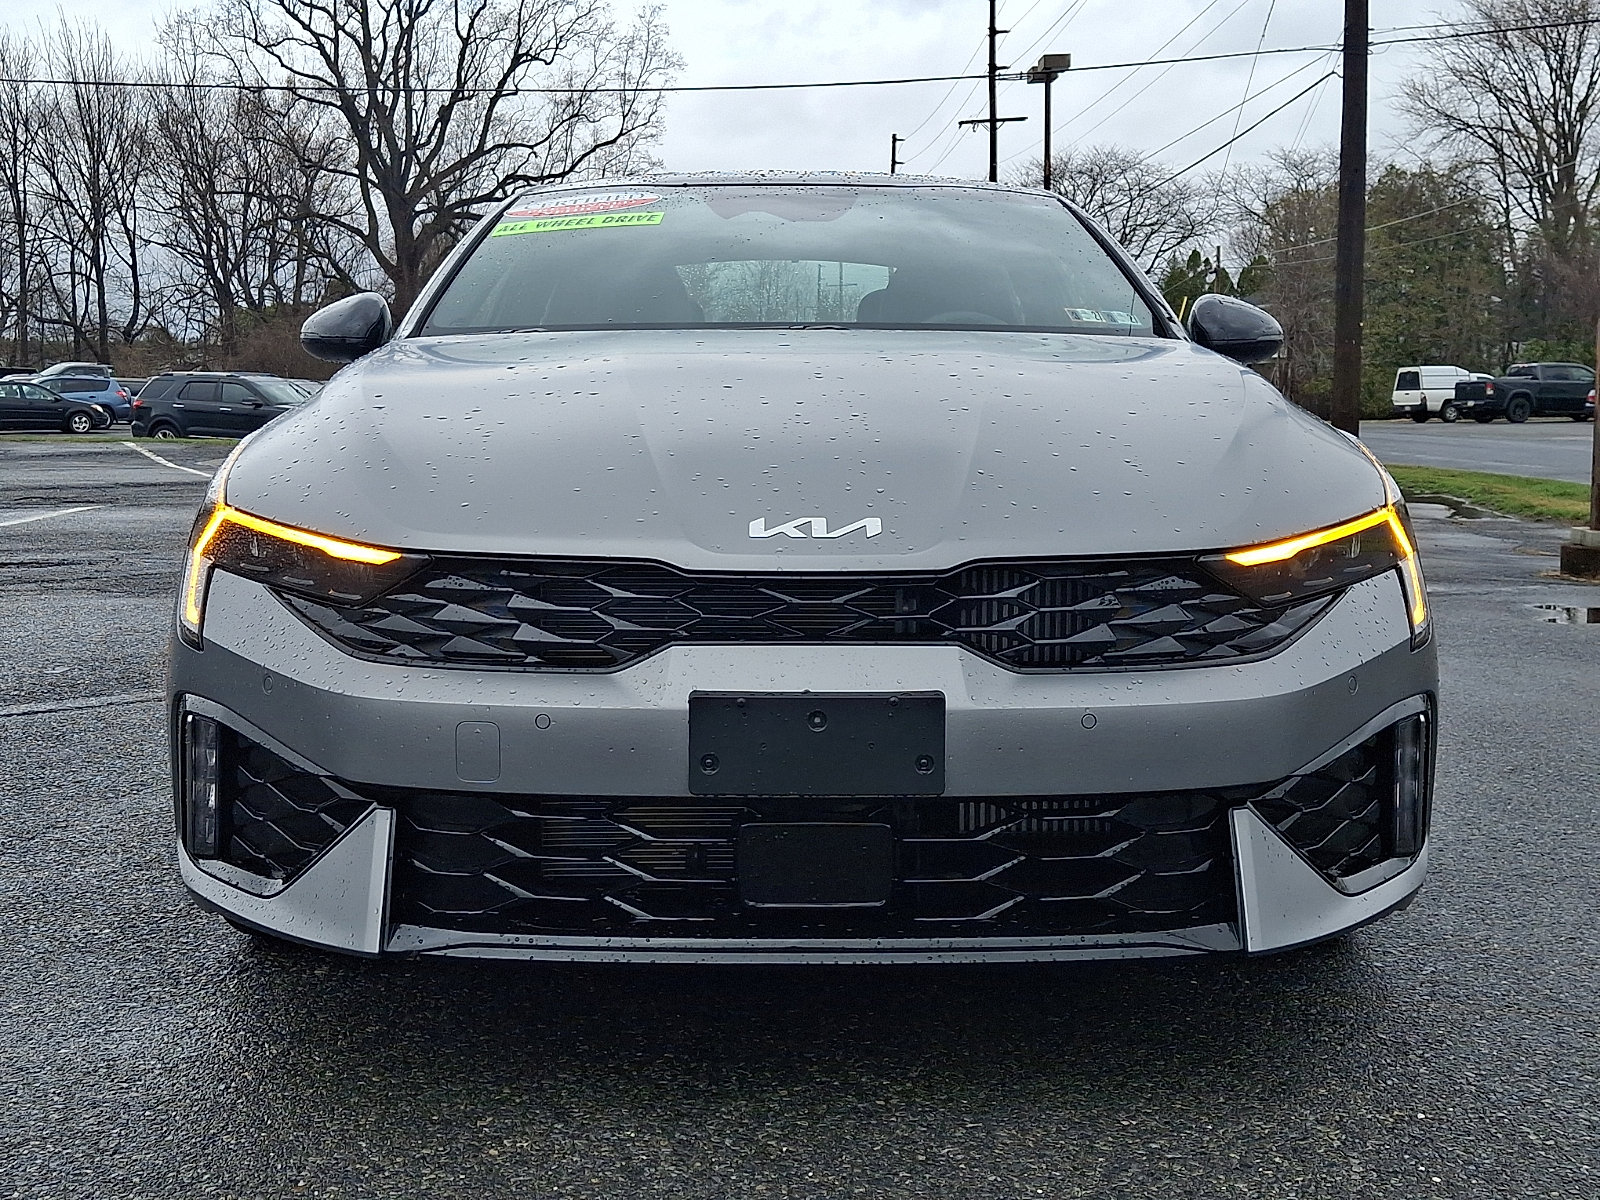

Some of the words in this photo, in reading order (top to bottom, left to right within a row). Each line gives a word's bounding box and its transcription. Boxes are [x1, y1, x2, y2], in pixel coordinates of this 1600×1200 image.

[497, 223, 528, 233] ALL
[536, 216, 596, 229] WHEEL
[602, 214, 660, 223] DRIVE
